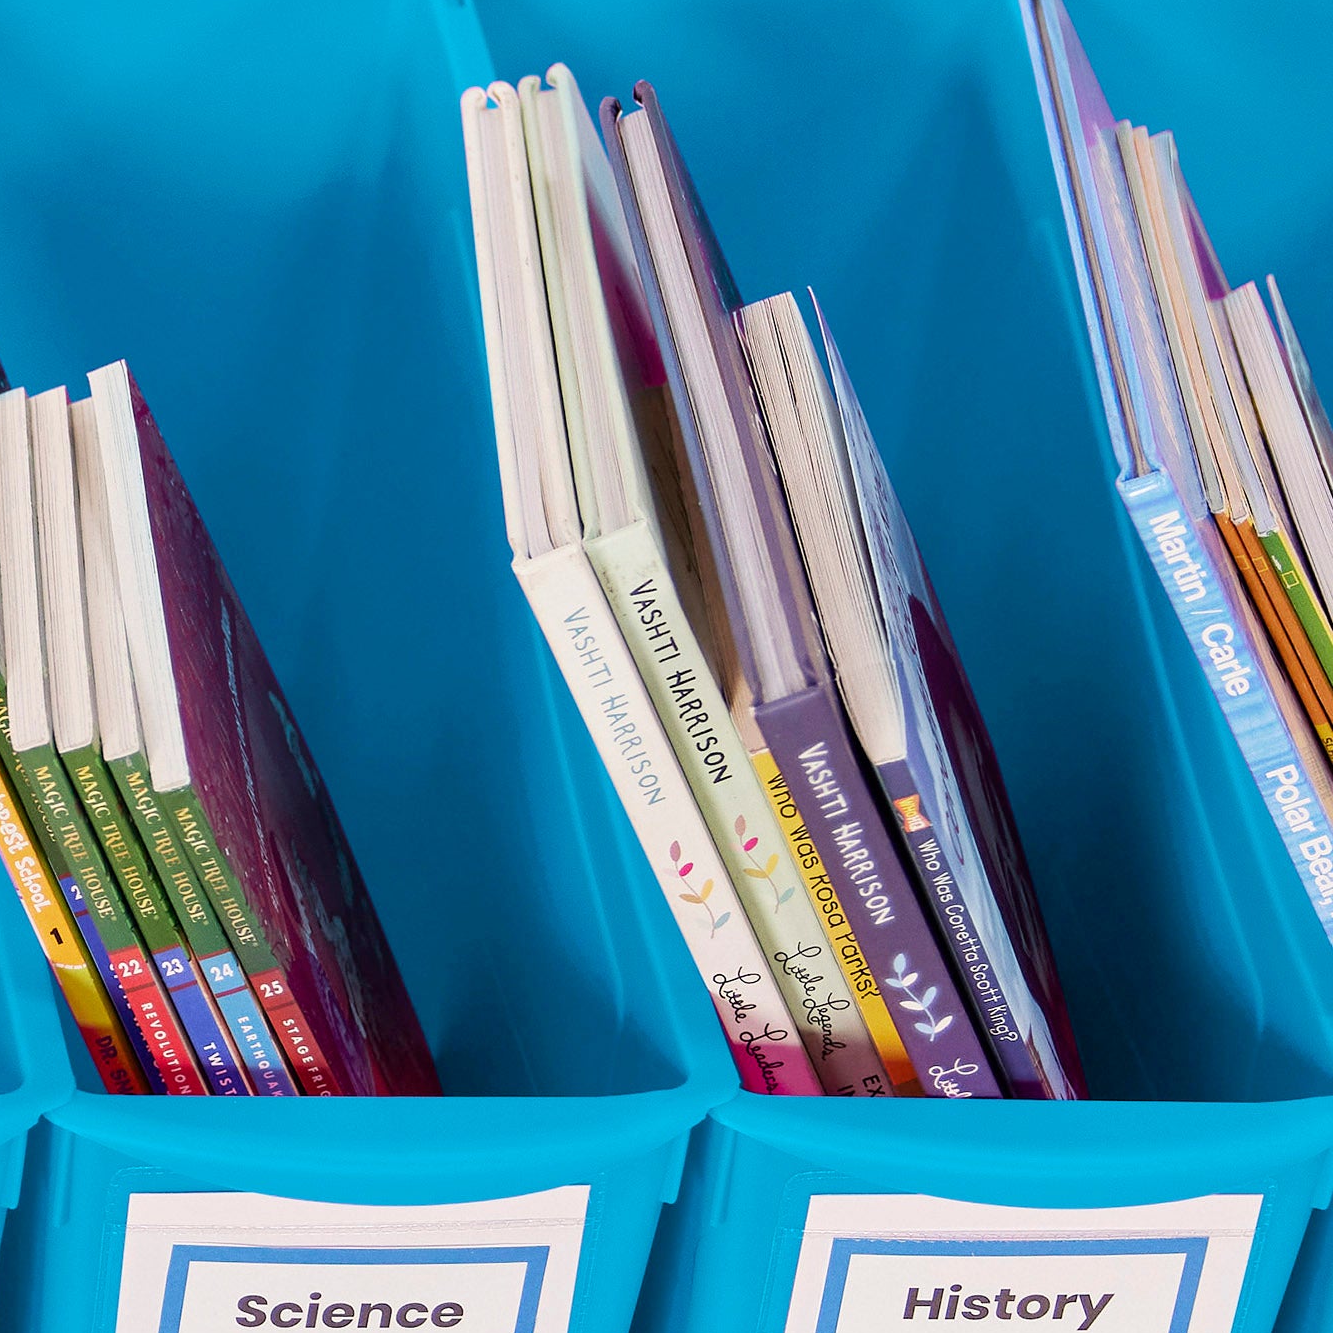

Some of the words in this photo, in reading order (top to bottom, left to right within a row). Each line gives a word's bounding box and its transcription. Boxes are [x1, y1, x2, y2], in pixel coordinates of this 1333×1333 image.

[1148, 509, 1207, 603] Martin
[1201, 623, 1251, 697] Carle
[563, 606, 613, 688] VASHTI
[601, 693, 666, 806] HARRISON
[629, 578, 681, 663] VASHTI
[666, 669, 733, 784] HARRISON
[34, 765, 69, 819] MAGIC
[60, 822, 88, 863] TREE
[80, 866, 113, 919] HOUSE
[75, 765, 110, 819] MAGIC
[102, 821, 131, 863] TREE
[122, 865, 156, 919] HOUSE
[126, 771, 161, 825] MAGIC
[152, 827, 181, 868] TREE
[172, 870, 205, 924] HOUSE
[798, 741, 849, 819] VASHTI
[831, 821, 895, 926] HARRISON
[1265, 764, 1317, 834] Polar
[174, 807, 210, 856] MAGIC
[201, 857, 229, 895] TREE
[221, 897, 254, 946] HOUSE
[767, 773, 798, 819] Who
[790, 824, 819, 870] Was
[809, 873, 846, 929] Rosa
[835, 931, 882, 1000] Parks?
[49, 927, 64, 945] 1
[118, 959, 143, 977] 22
[161, 958, 184, 977] 23
[209, 964, 234, 982] 24
[259, 980, 284, 998] 25
[918, 839, 940, 871] Who
[933, 871, 953, 903] Was
[945, 903, 980, 963] Coretta
[970, 963, 1001, 1005] Scott
[988, 1002, 1019, 1043] King?
[140, 1001, 192, 1094] REVOLUTION
[283, 1018, 314, 1065] STAGE
[713, 966, 761, 1023] Little
[739, 1023, 788, 1095] Leaders
[774, 941, 824, 996] Little
[802, 992, 850, 1061] Legends
[109, 1069, 133, 1094] SN
[203, 1042, 238, 1095] TWIST
[235, 1290, 464, 1329] Science
[902, 1283, 1114, 1333] History
